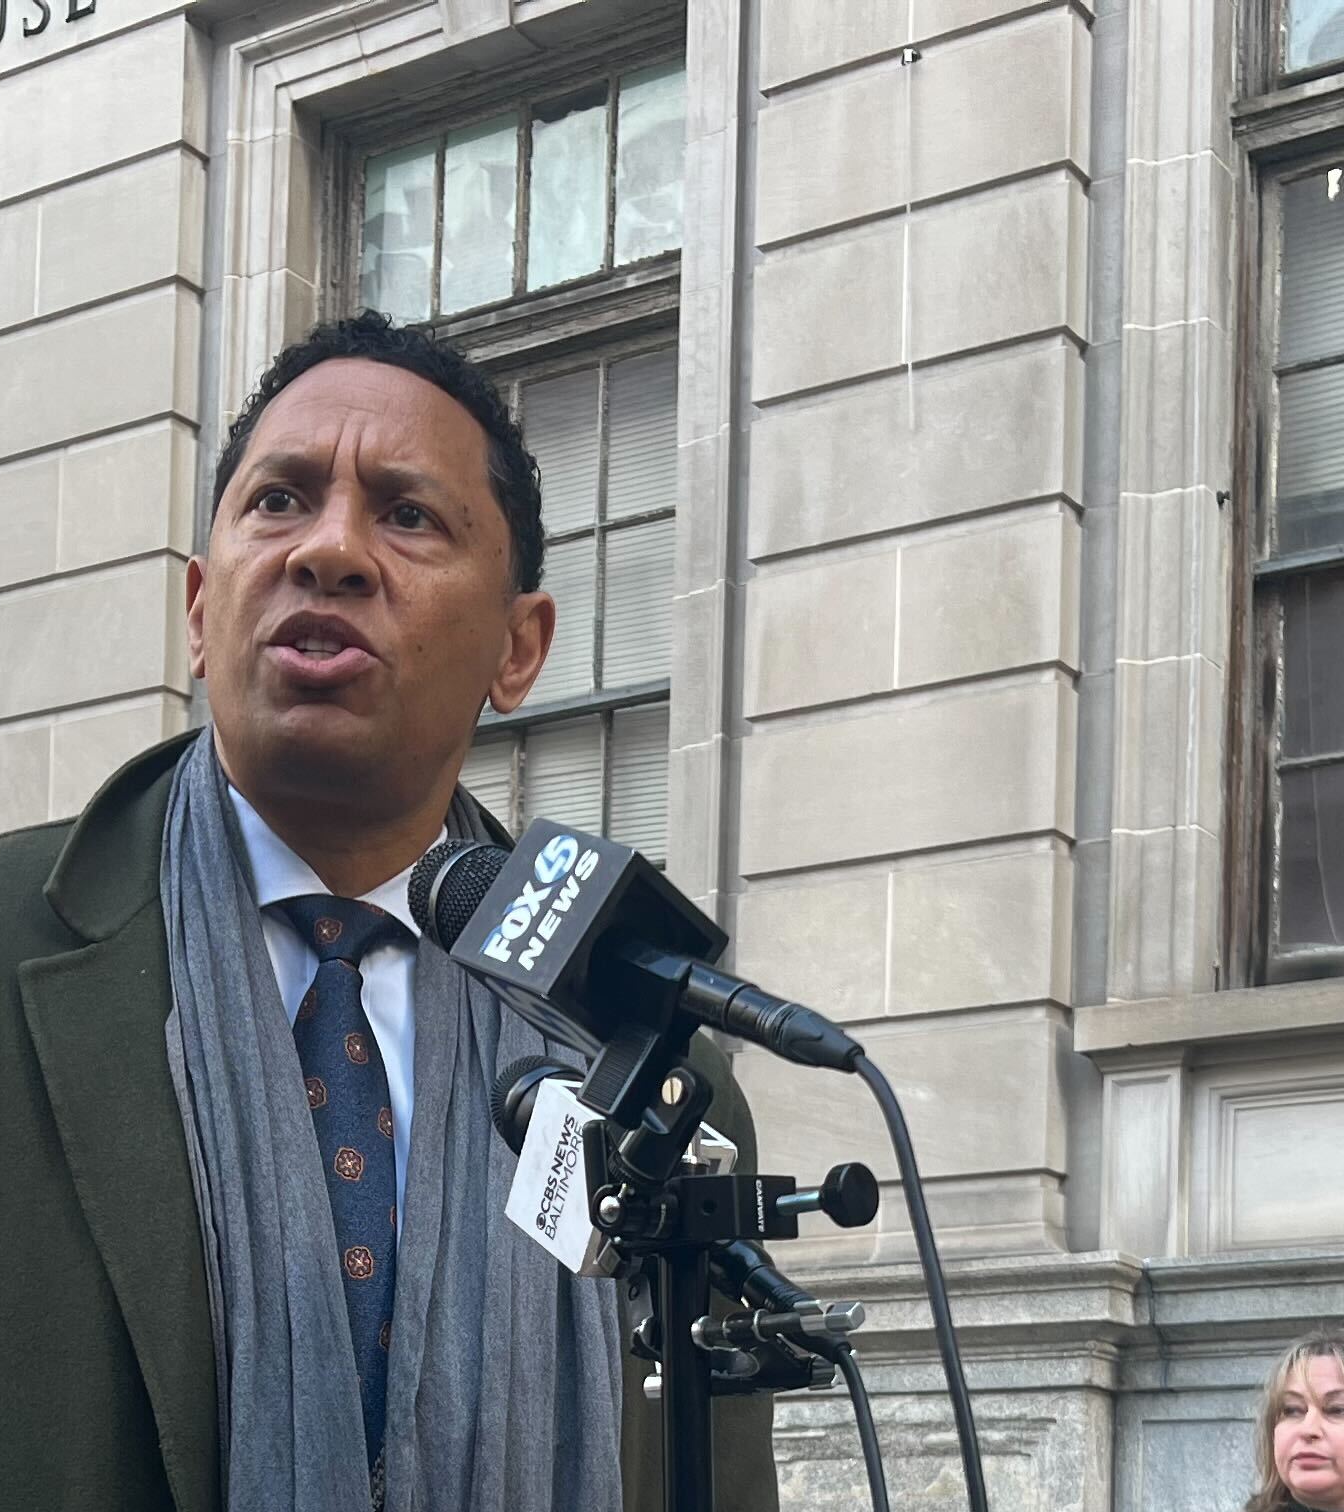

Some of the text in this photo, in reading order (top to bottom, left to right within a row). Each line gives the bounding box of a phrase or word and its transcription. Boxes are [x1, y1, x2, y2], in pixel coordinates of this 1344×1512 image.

[518, 849, 599, 971] NEWS
[540, 1113, 575, 1214] CBS NEWS
[544, 1120, 585, 1241] BALTIMORE
